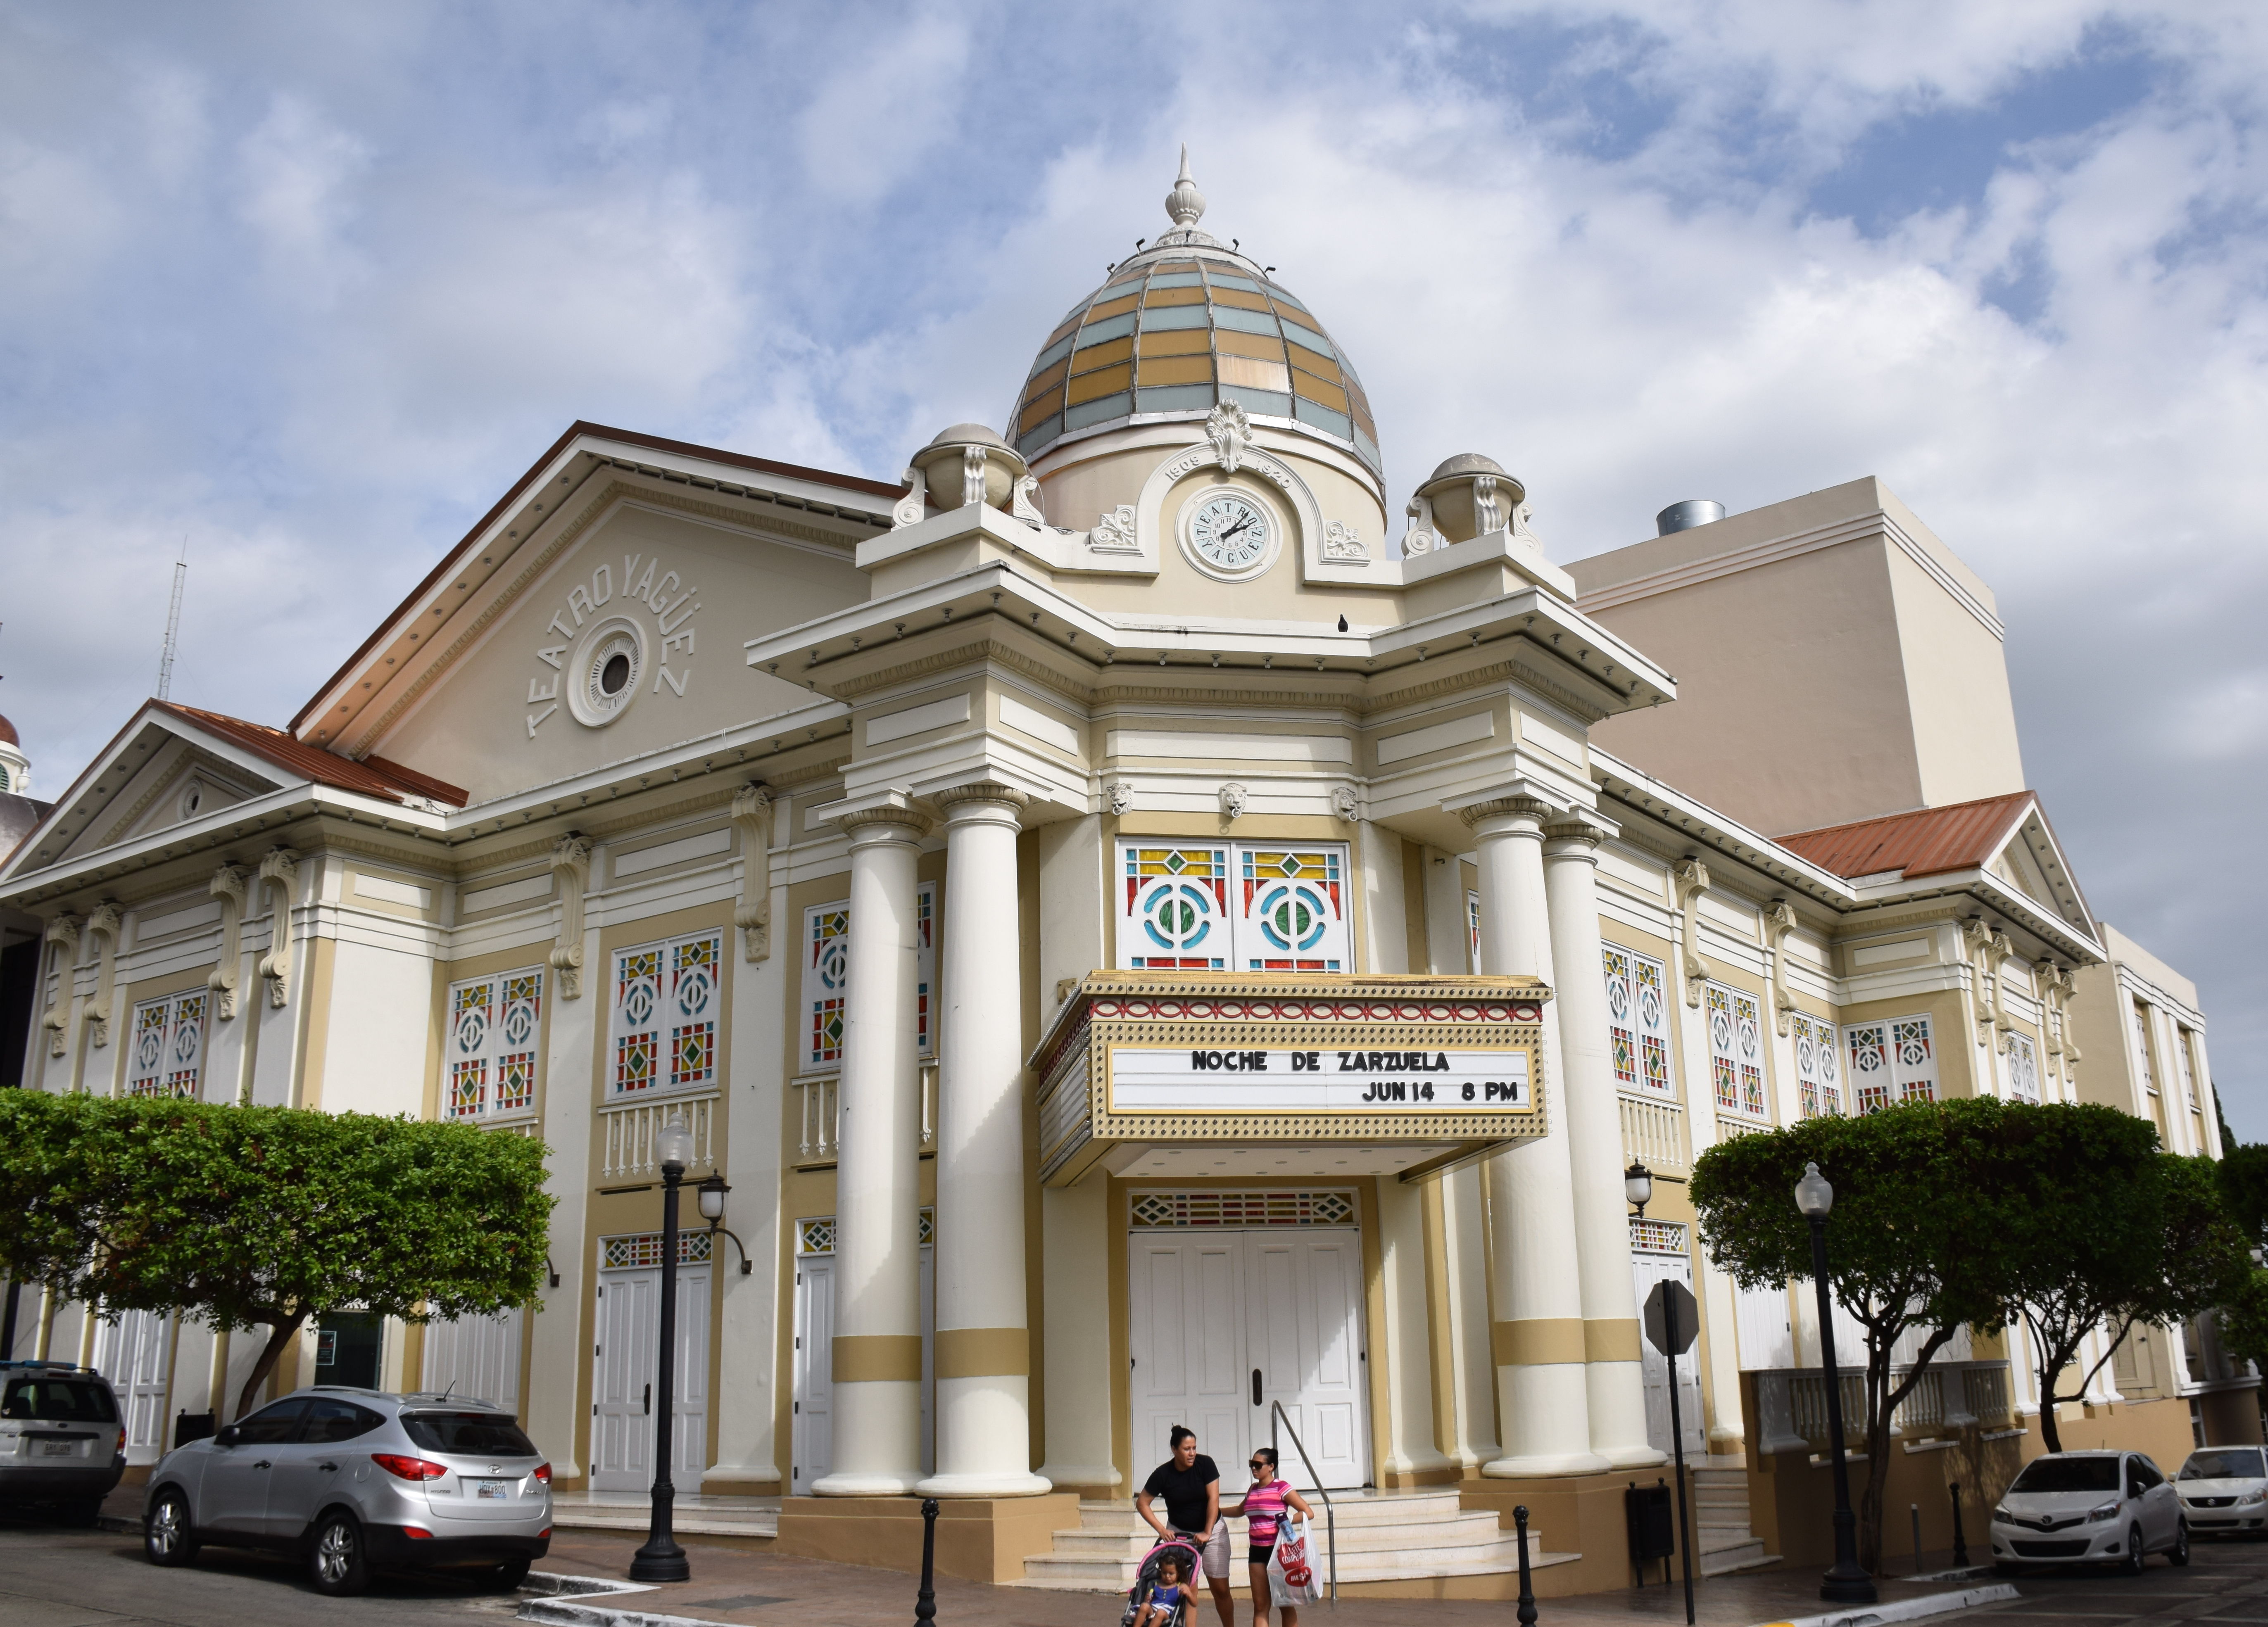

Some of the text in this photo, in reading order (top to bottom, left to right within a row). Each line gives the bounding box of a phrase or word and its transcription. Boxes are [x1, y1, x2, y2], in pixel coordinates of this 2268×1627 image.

[1165, 455, 1201, 481] 1909
[1256, 459, 1291, 489] 1920
[526, 553, 701, 739] TEATRO YAGÜEZ
[1192, 1050, 1450, 1071] NOCHE DE ZARZUELA
[1362, 1081, 1518, 1101] JUN 14 8 PM
